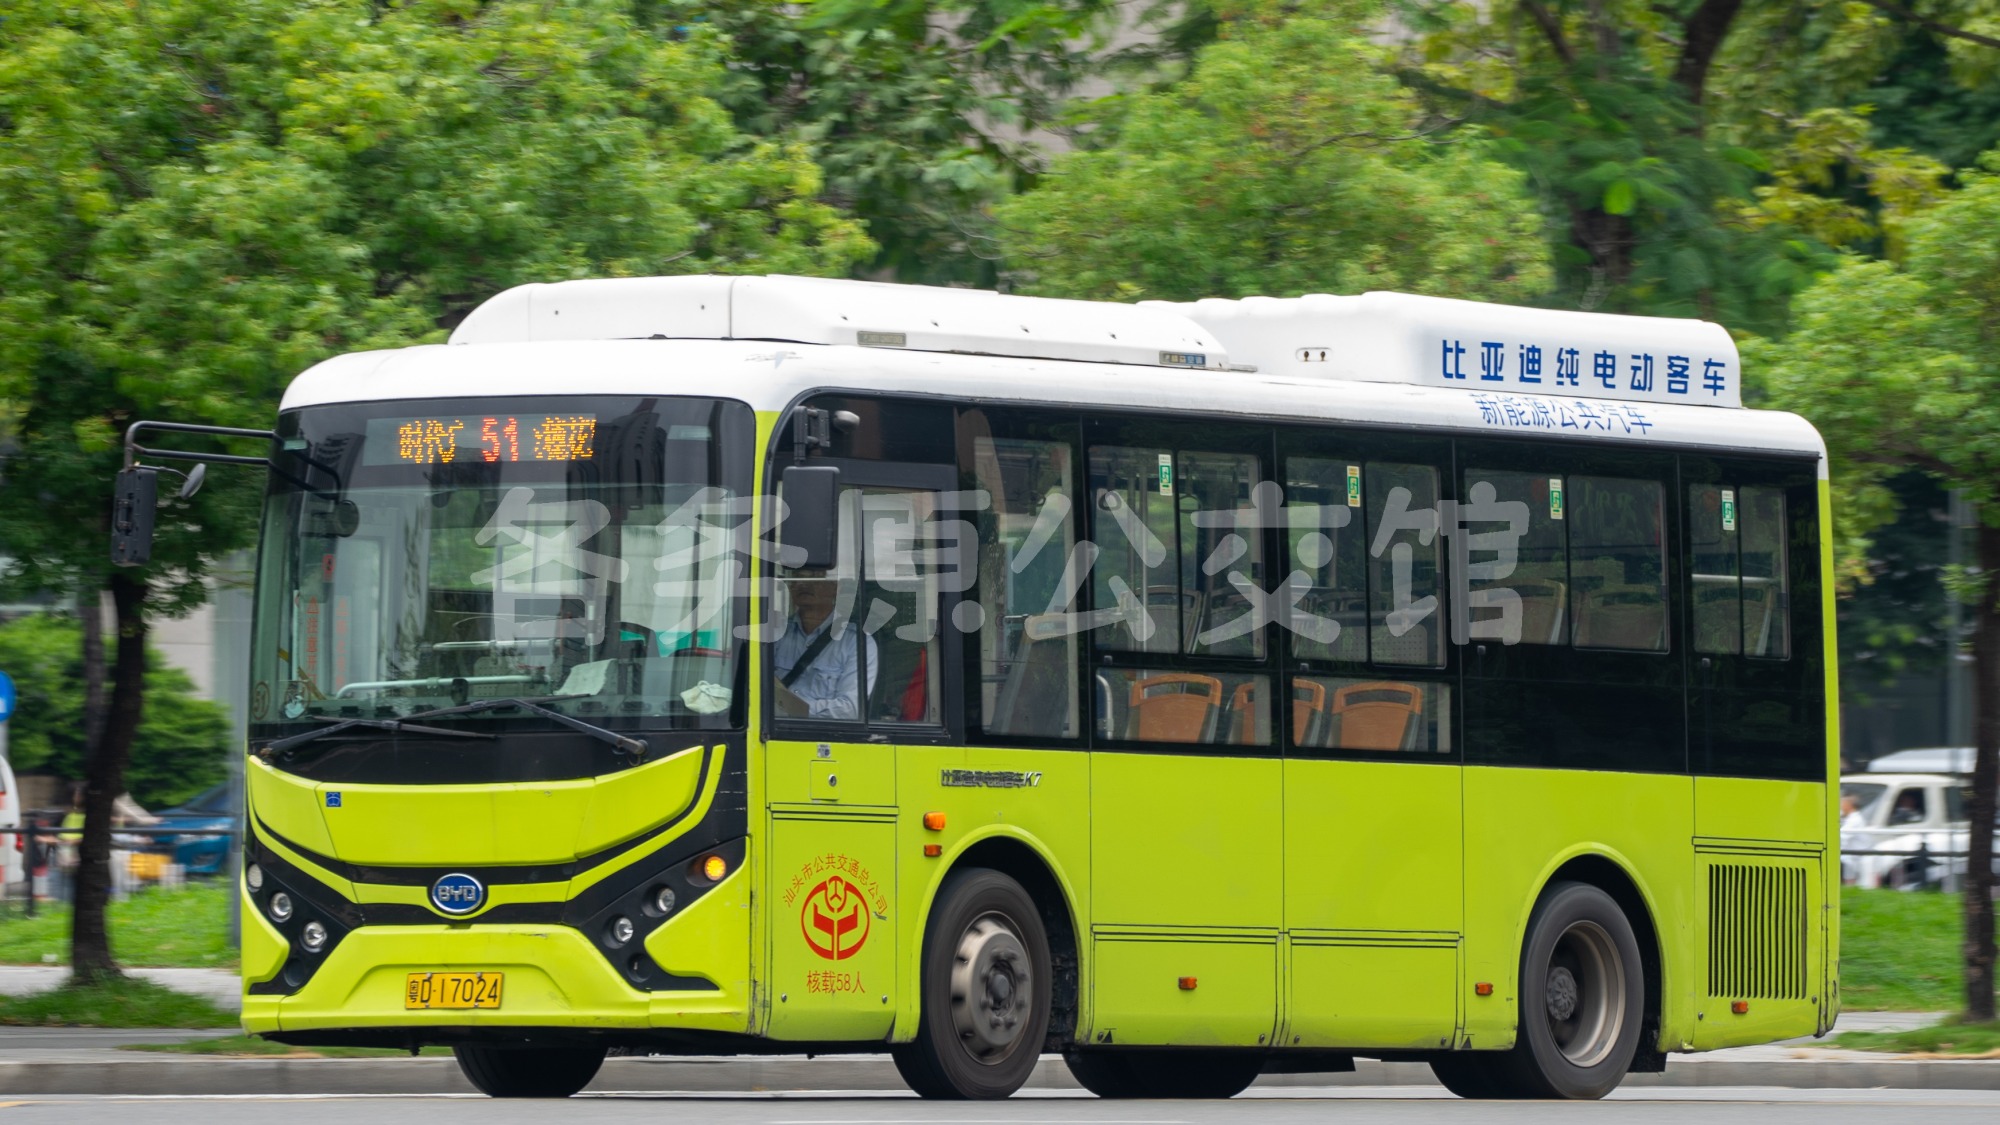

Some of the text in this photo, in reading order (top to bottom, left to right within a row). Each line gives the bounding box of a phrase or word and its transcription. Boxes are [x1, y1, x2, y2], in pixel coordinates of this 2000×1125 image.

[1442, 339, 1726, 397] 比亚迪纯电动客车
[1470, 393, 1653, 435] 新能源公共汽车
[481, 417, 519, 462] 51
[437, 885, 477, 902] BYD
[782, 852, 887, 915] 汕头市公共交通总公司
[806, 969, 866, 994] 核载58人
